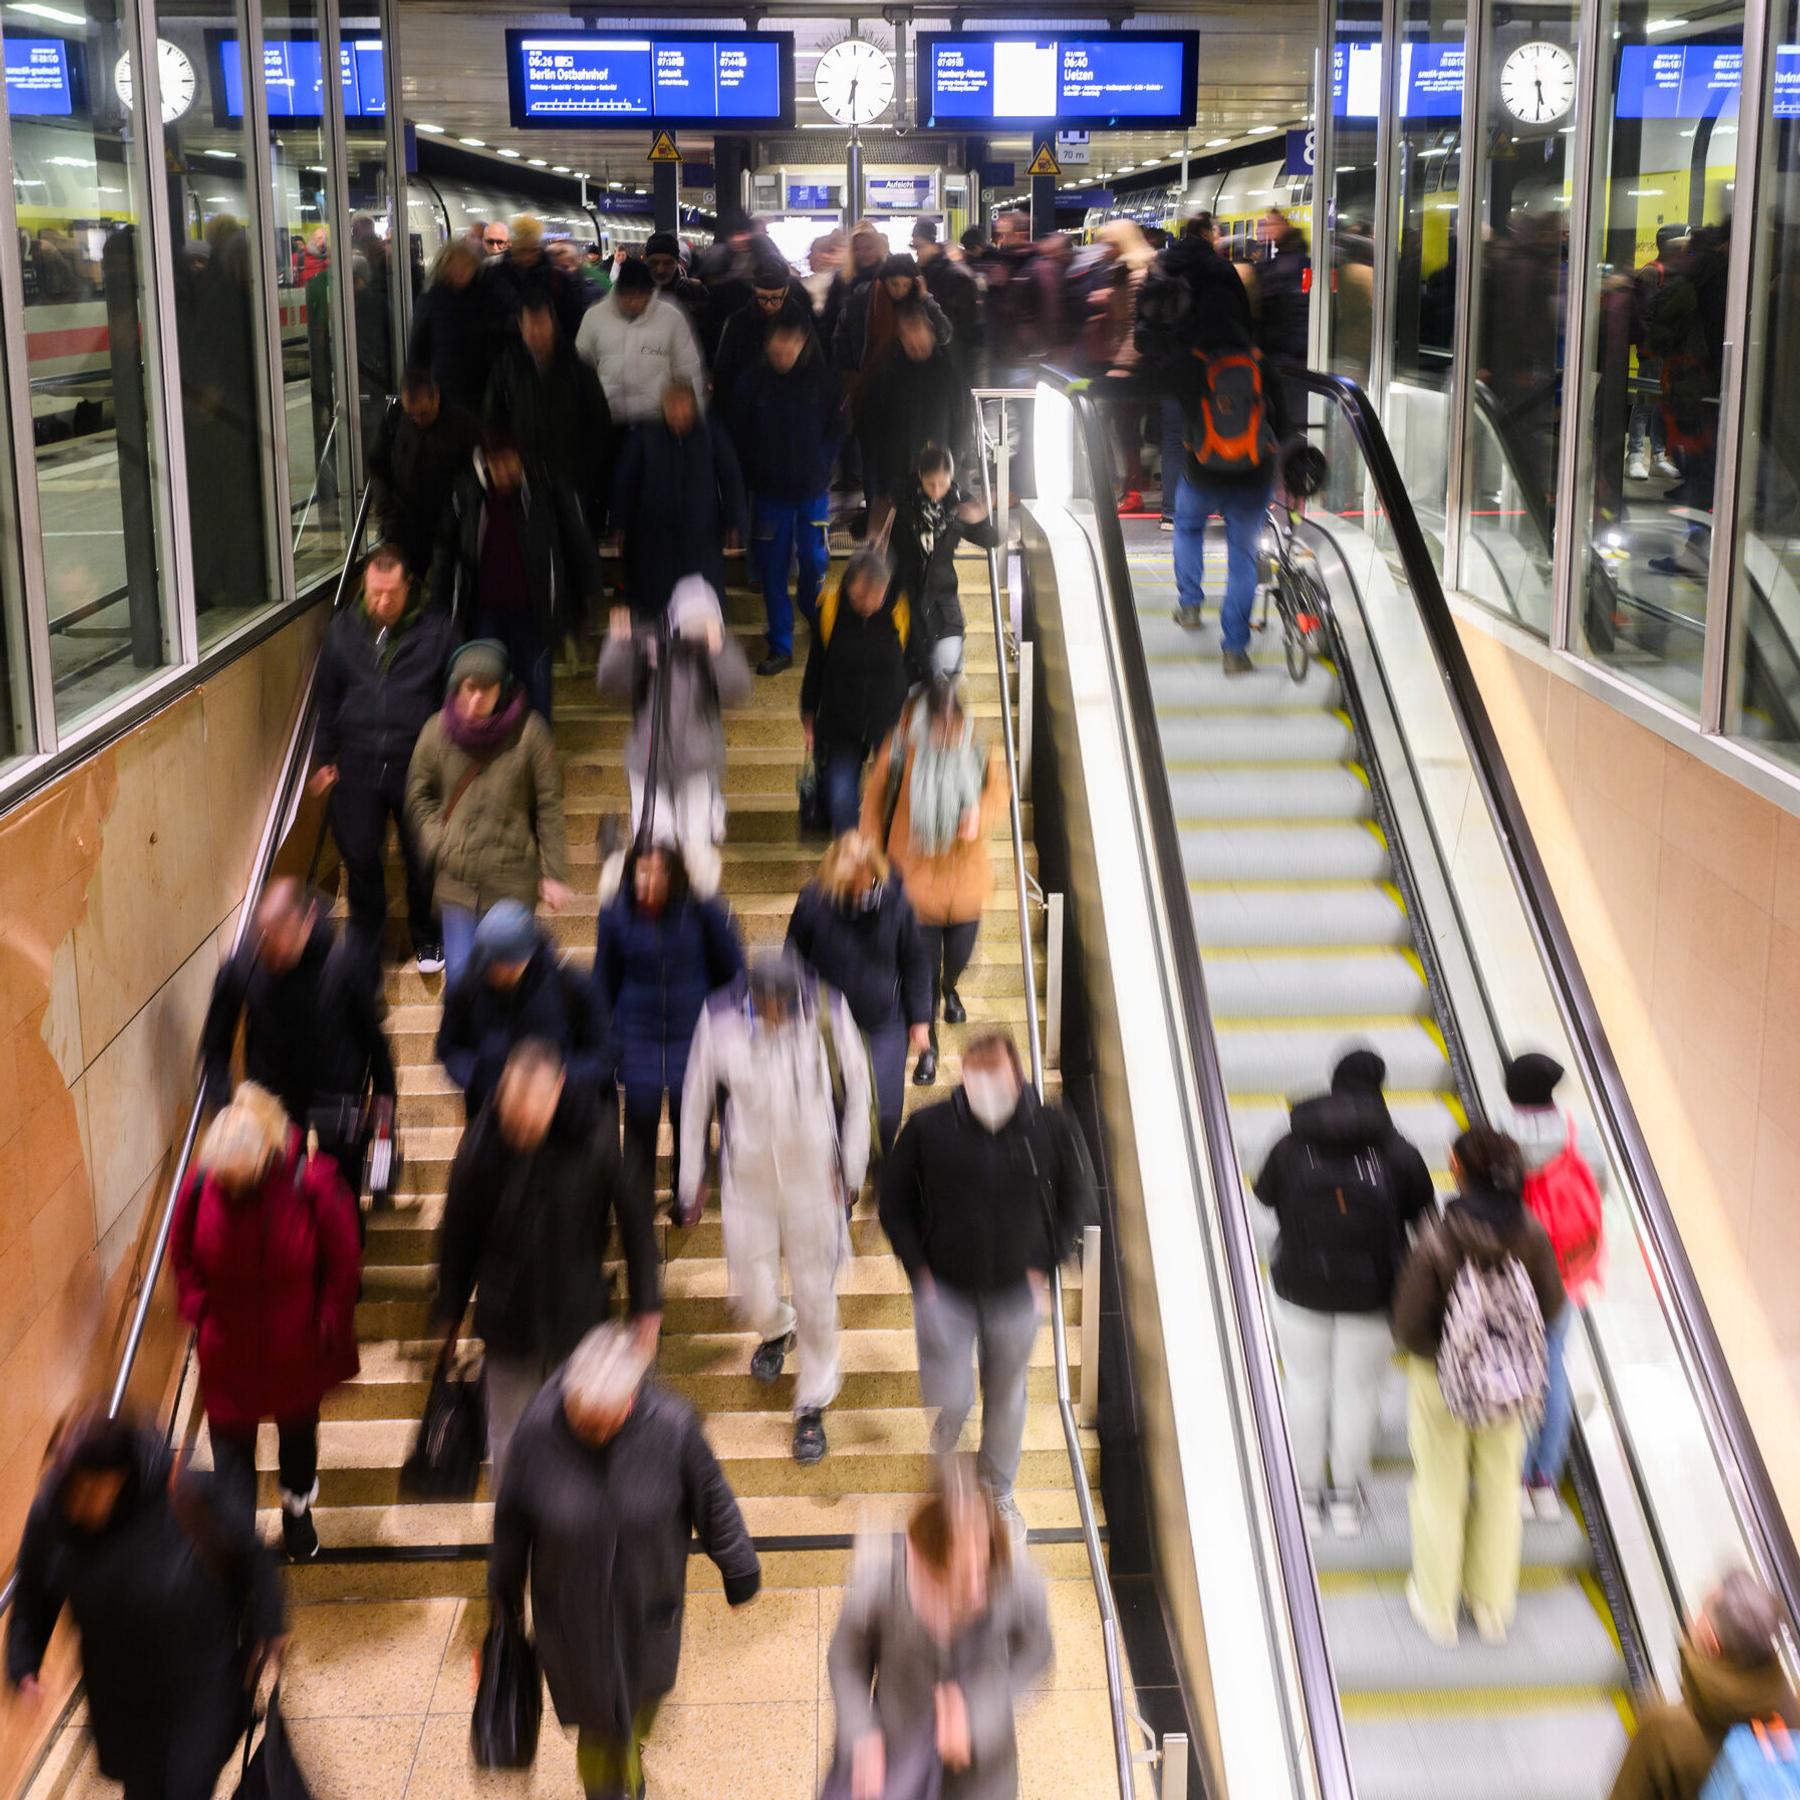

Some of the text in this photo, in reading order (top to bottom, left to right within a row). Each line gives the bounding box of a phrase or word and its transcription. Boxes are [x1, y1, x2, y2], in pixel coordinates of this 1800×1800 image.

[528, 56, 553, 67] 06:26
[529, 67, 609, 81] Berlin Ostbahnhof
[1063, 68, 1094, 81] Uelzen
